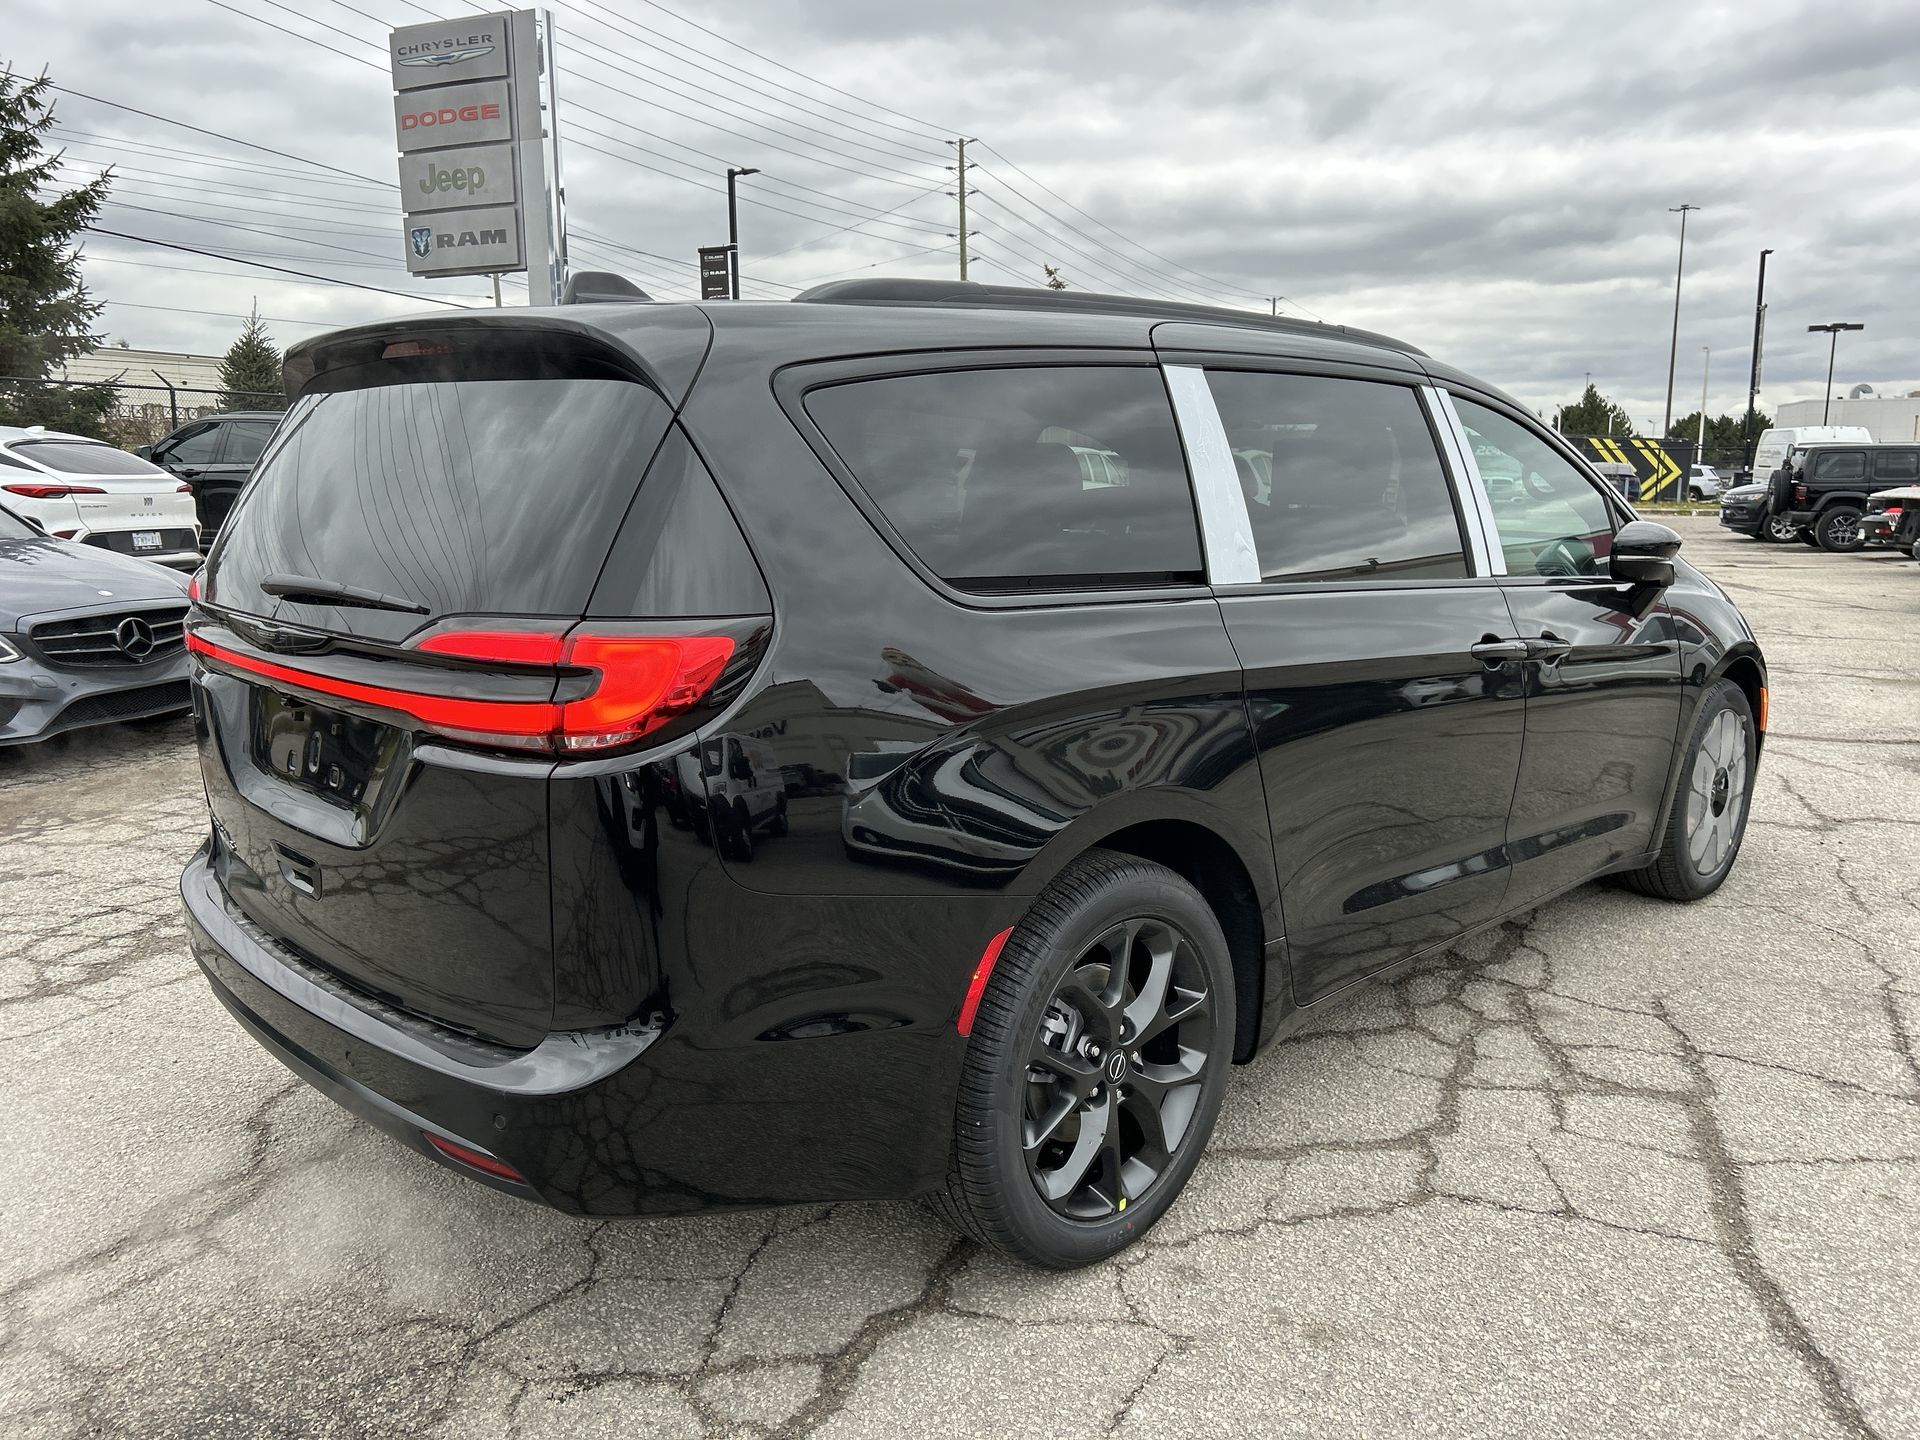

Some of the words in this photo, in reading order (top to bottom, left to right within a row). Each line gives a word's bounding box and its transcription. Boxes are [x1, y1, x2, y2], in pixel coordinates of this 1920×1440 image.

[398, 34, 494, 56] CHRYSLER
[402, 104, 500, 130] DODGE
[420, 163, 485, 195] Jeep
[436, 228, 507, 249] RAM
